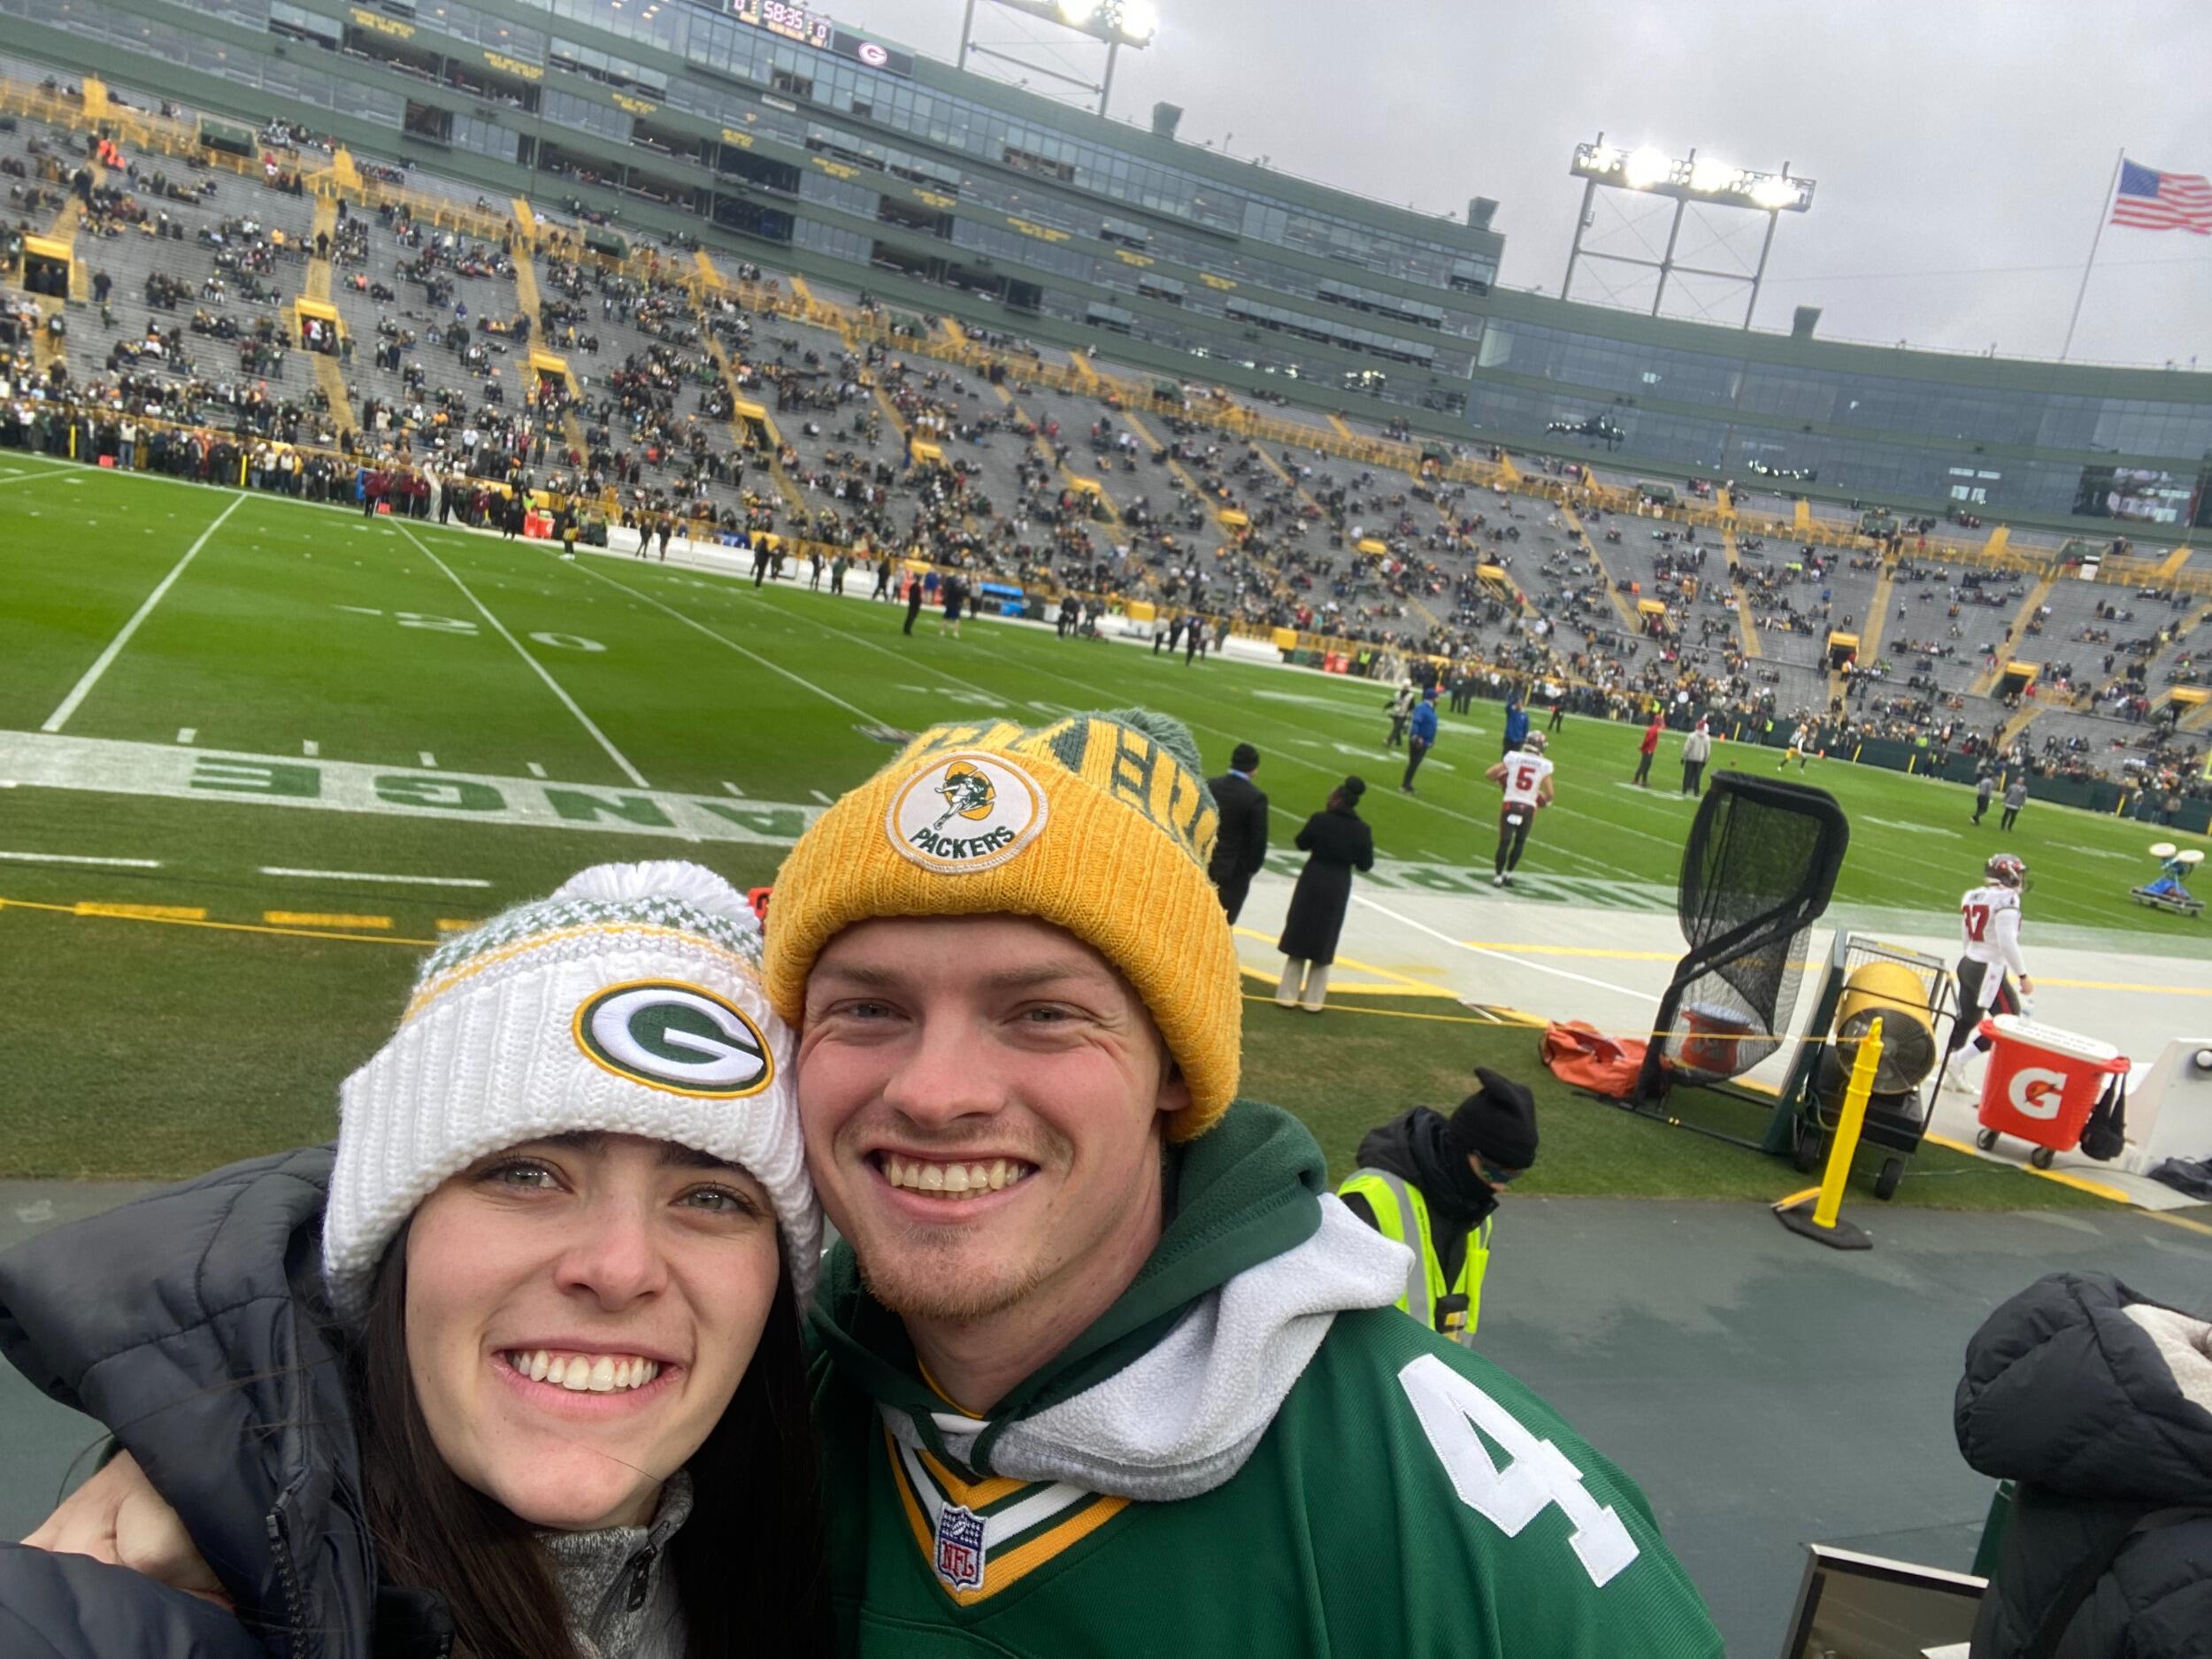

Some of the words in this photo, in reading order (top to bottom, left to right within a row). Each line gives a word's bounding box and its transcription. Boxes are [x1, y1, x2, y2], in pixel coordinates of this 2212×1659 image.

[763, 1, 803, 29] 58:35
[817, 25, 826, 38] 0
[860, 43, 887, 64] G
[1516, 766, 1535, 790] 5
[910, 826, 1016, 858] PACKERS
[592, 989, 764, 1086] G
[2008, 1067, 2067, 1119] G
[1397, 1354, 1640, 1588] 4
[941, 1540, 974, 1578] NFL
